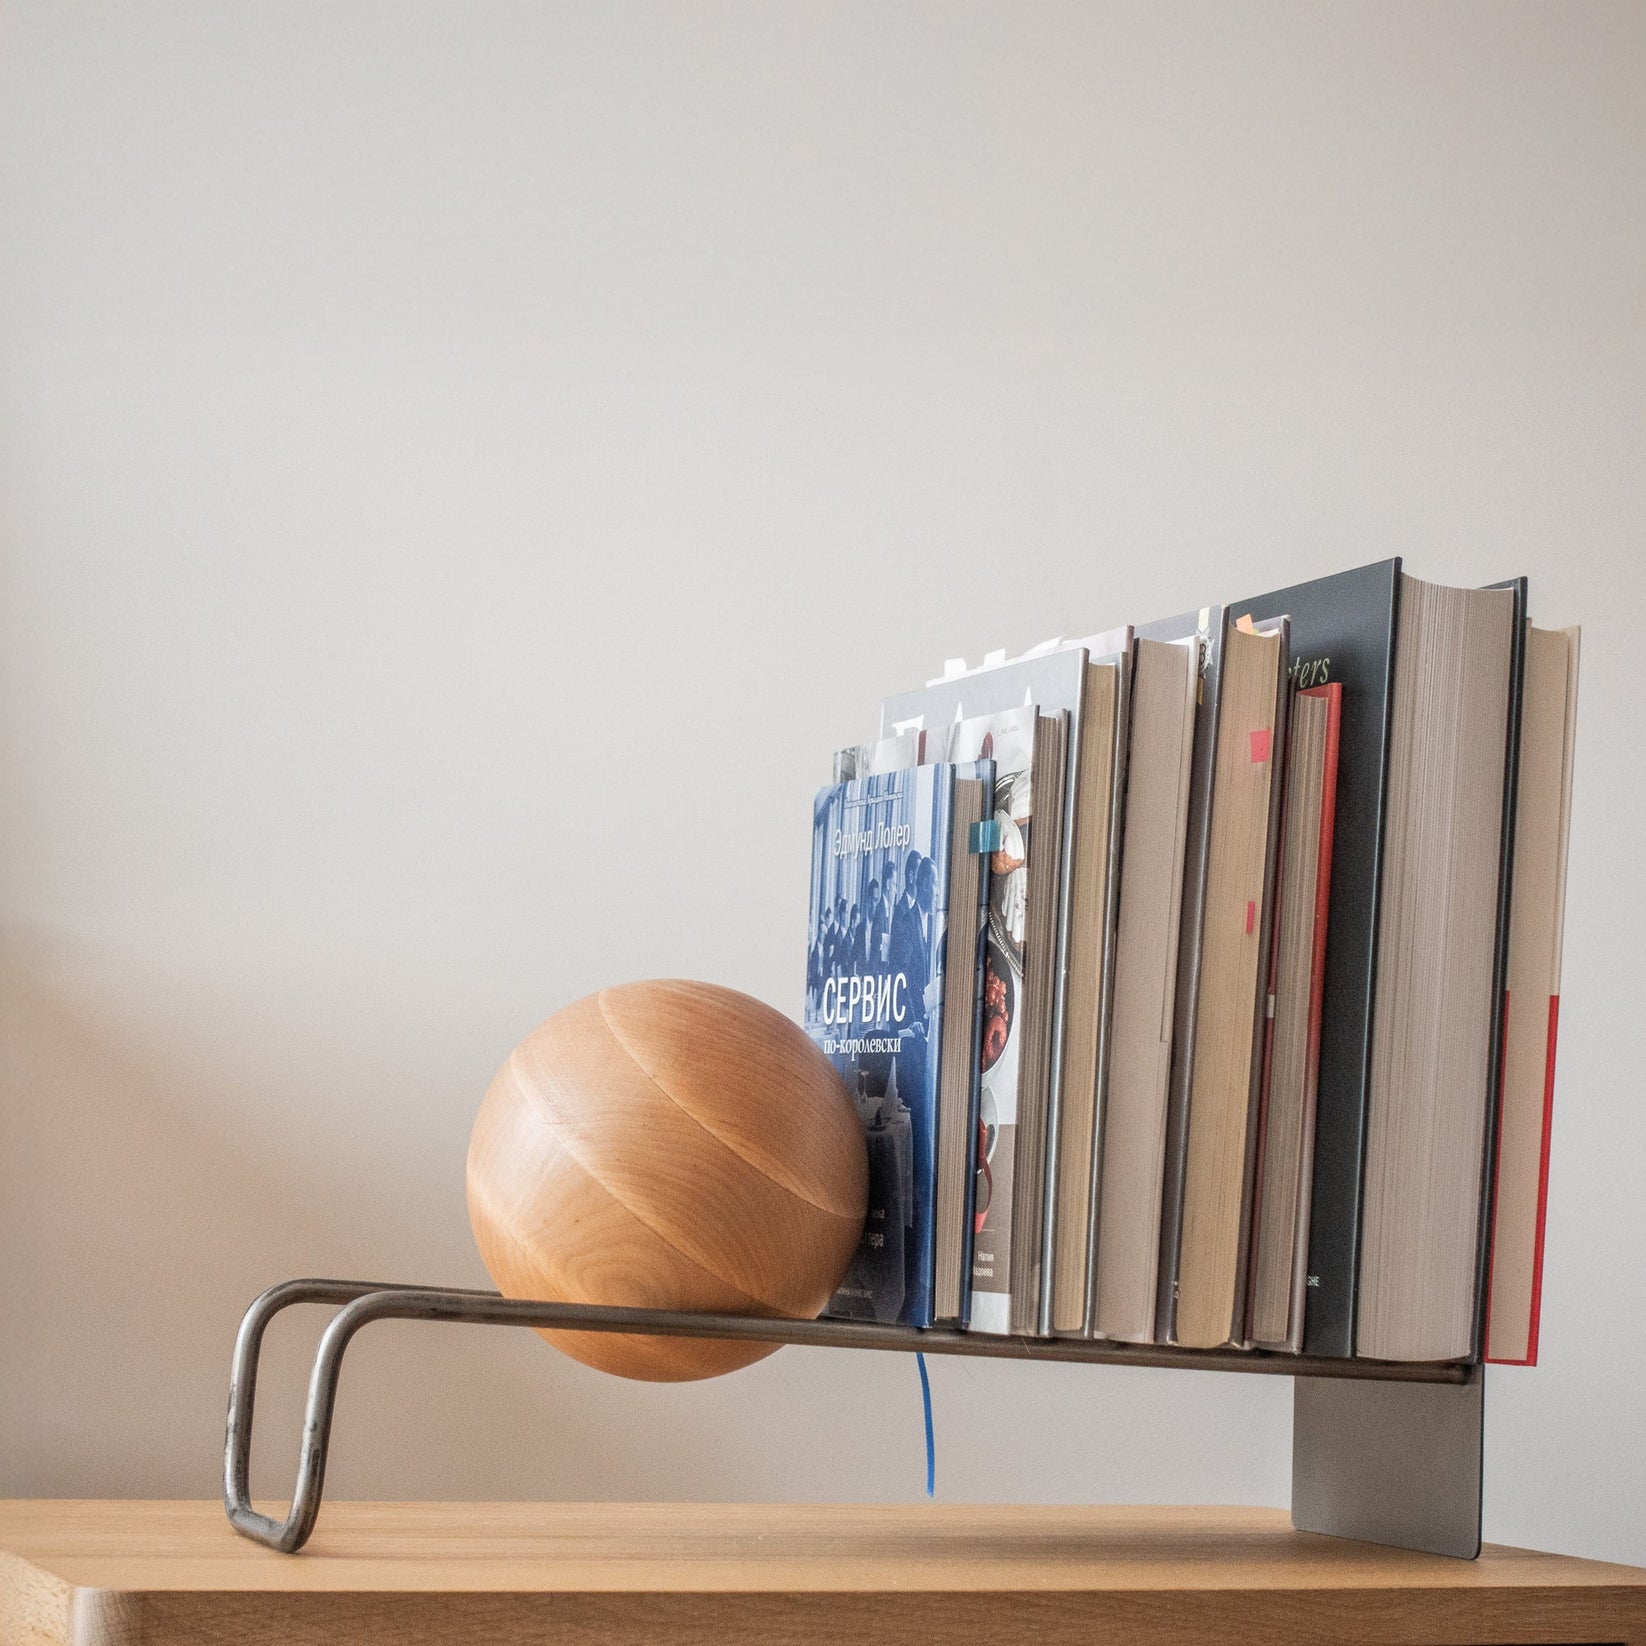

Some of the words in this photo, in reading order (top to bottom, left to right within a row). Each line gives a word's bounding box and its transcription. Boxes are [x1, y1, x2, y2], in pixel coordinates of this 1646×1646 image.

[1288, 656, 1330, 689] ters
[834, 829, 873, 860] Эдмунд
[875, 821, 910, 852] Лолер
[823, 972, 907, 1025] СЕРВИС
[823, 1037, 902, 1062] по-королевски
